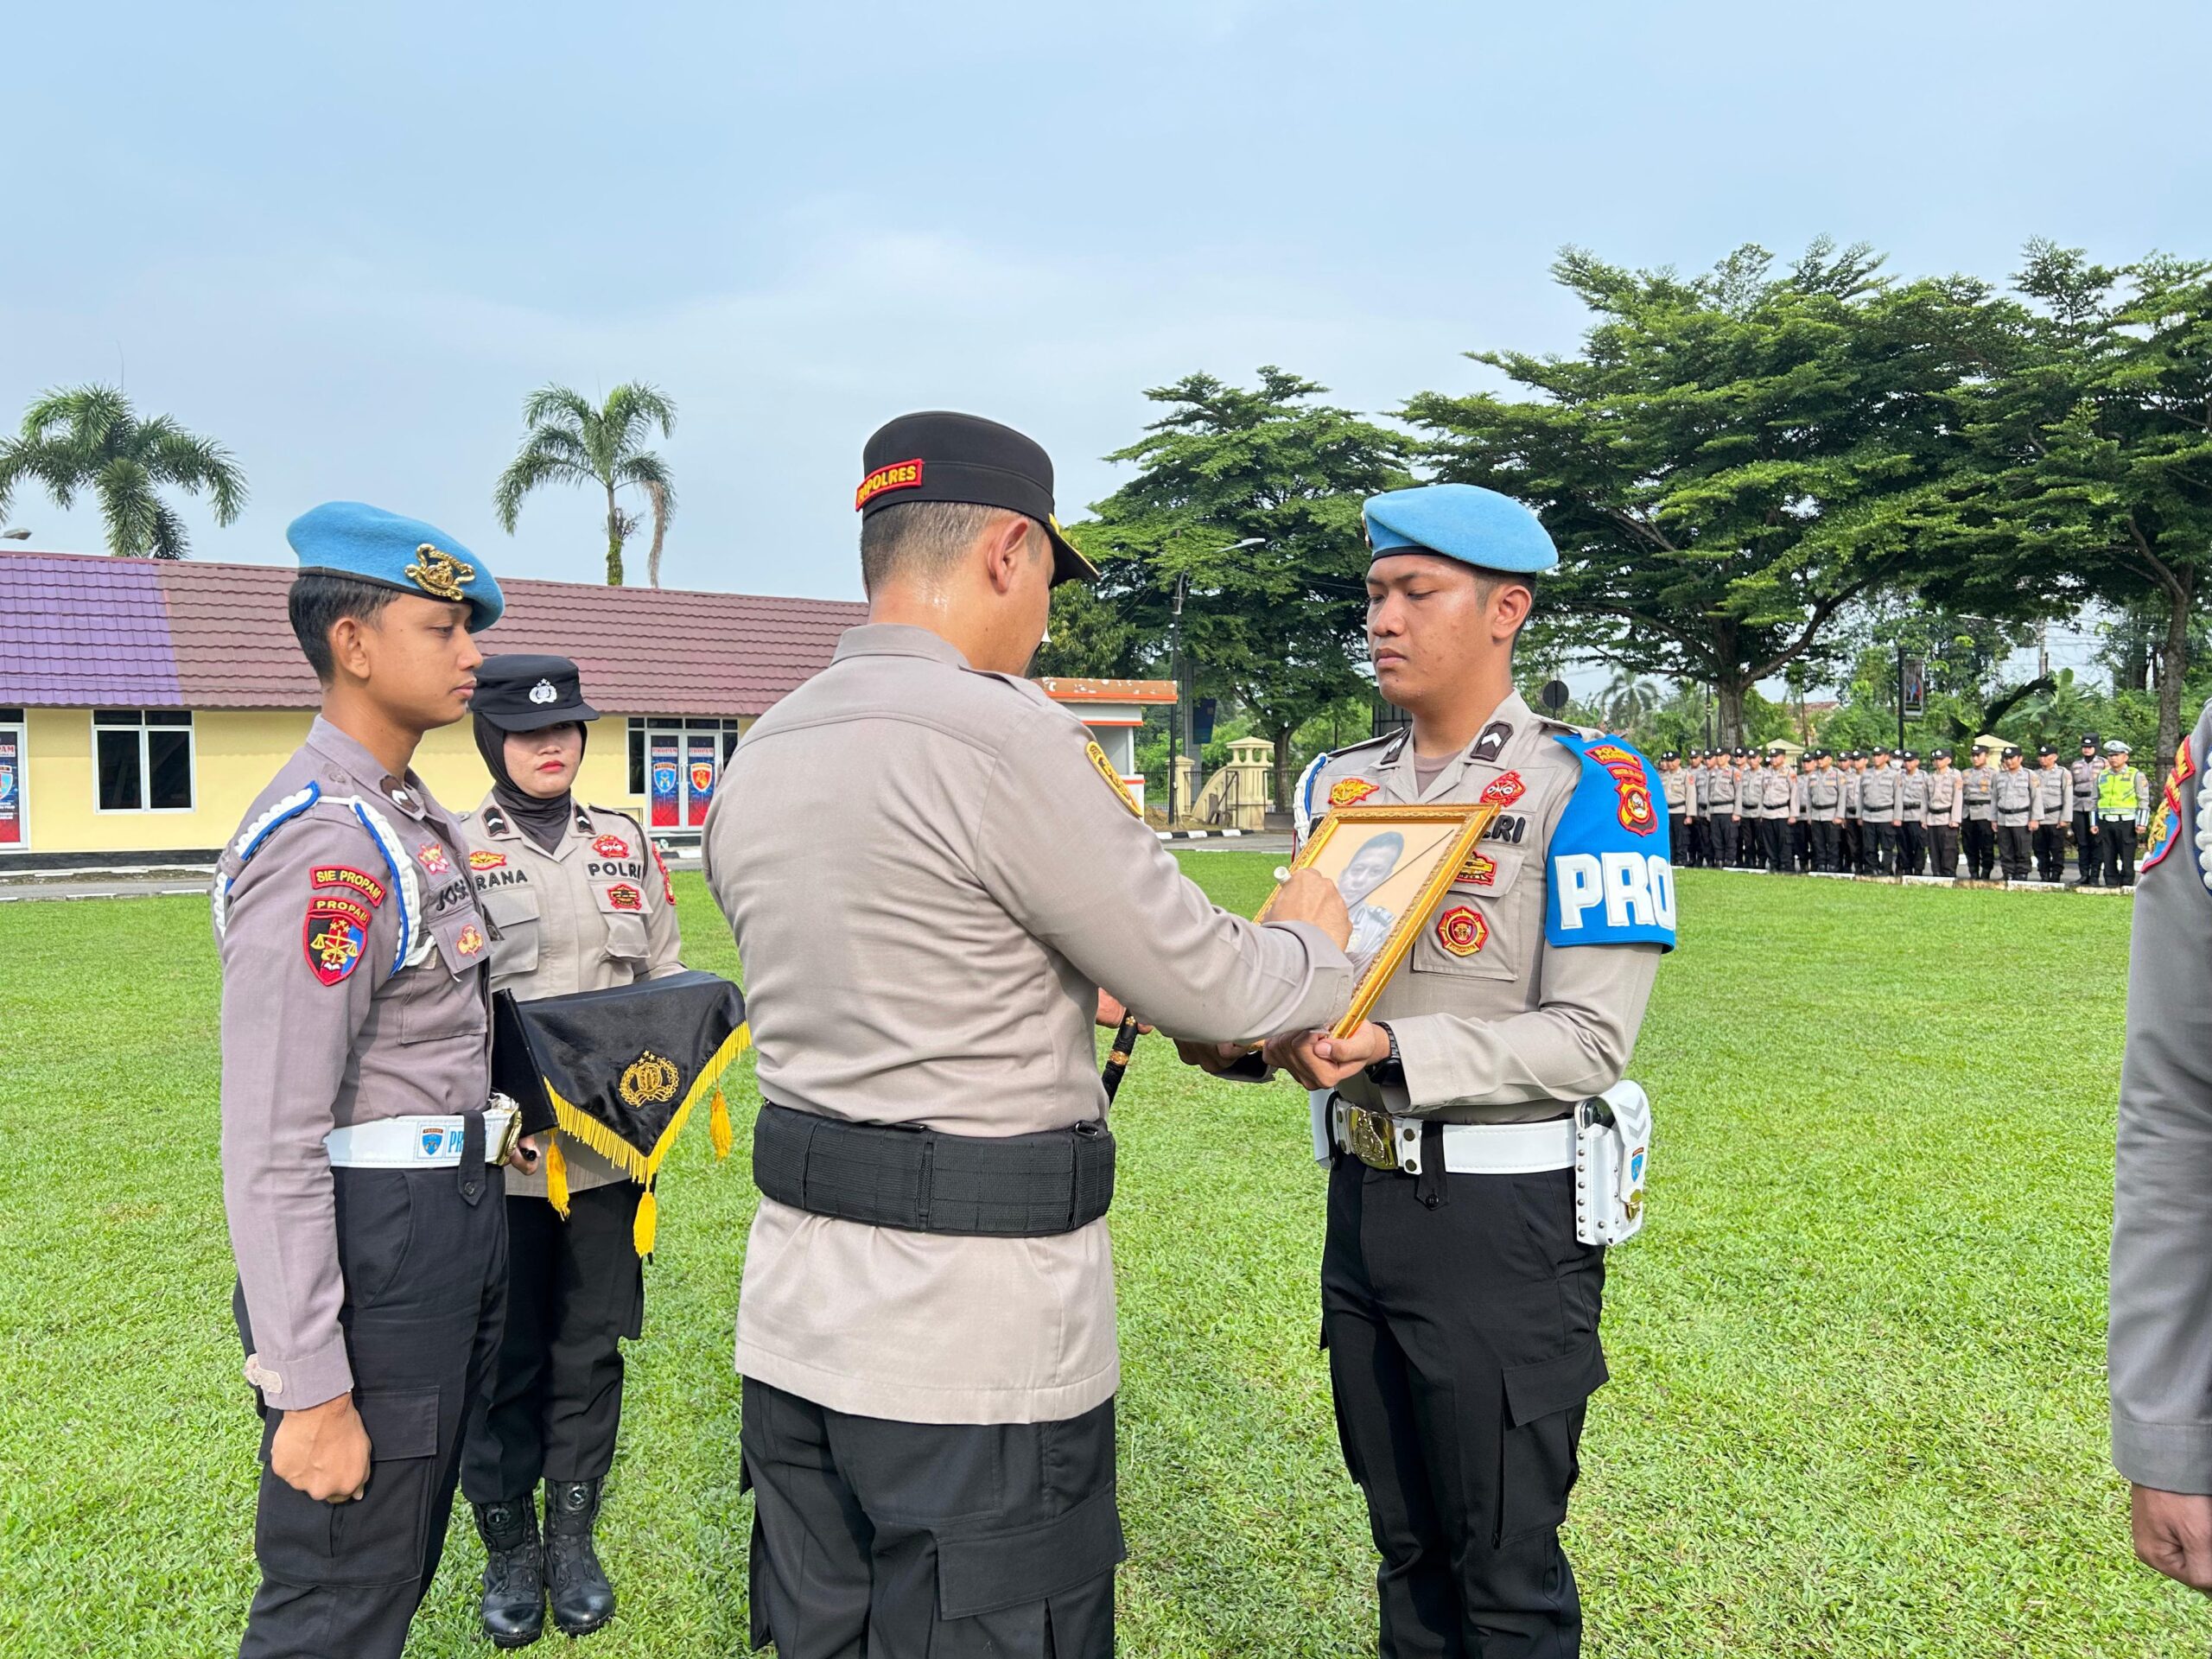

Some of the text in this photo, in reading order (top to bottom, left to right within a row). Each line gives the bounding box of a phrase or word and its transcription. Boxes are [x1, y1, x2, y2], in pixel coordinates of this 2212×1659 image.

[474, 869, 528, 891] RANA
[588, 861, 641, 880] POLRI
[316, 870, 382, 899] SIE PROPAM
[1554, 851, 1676, 931] PRO
[316, 900, 368, 921] PROPAM
